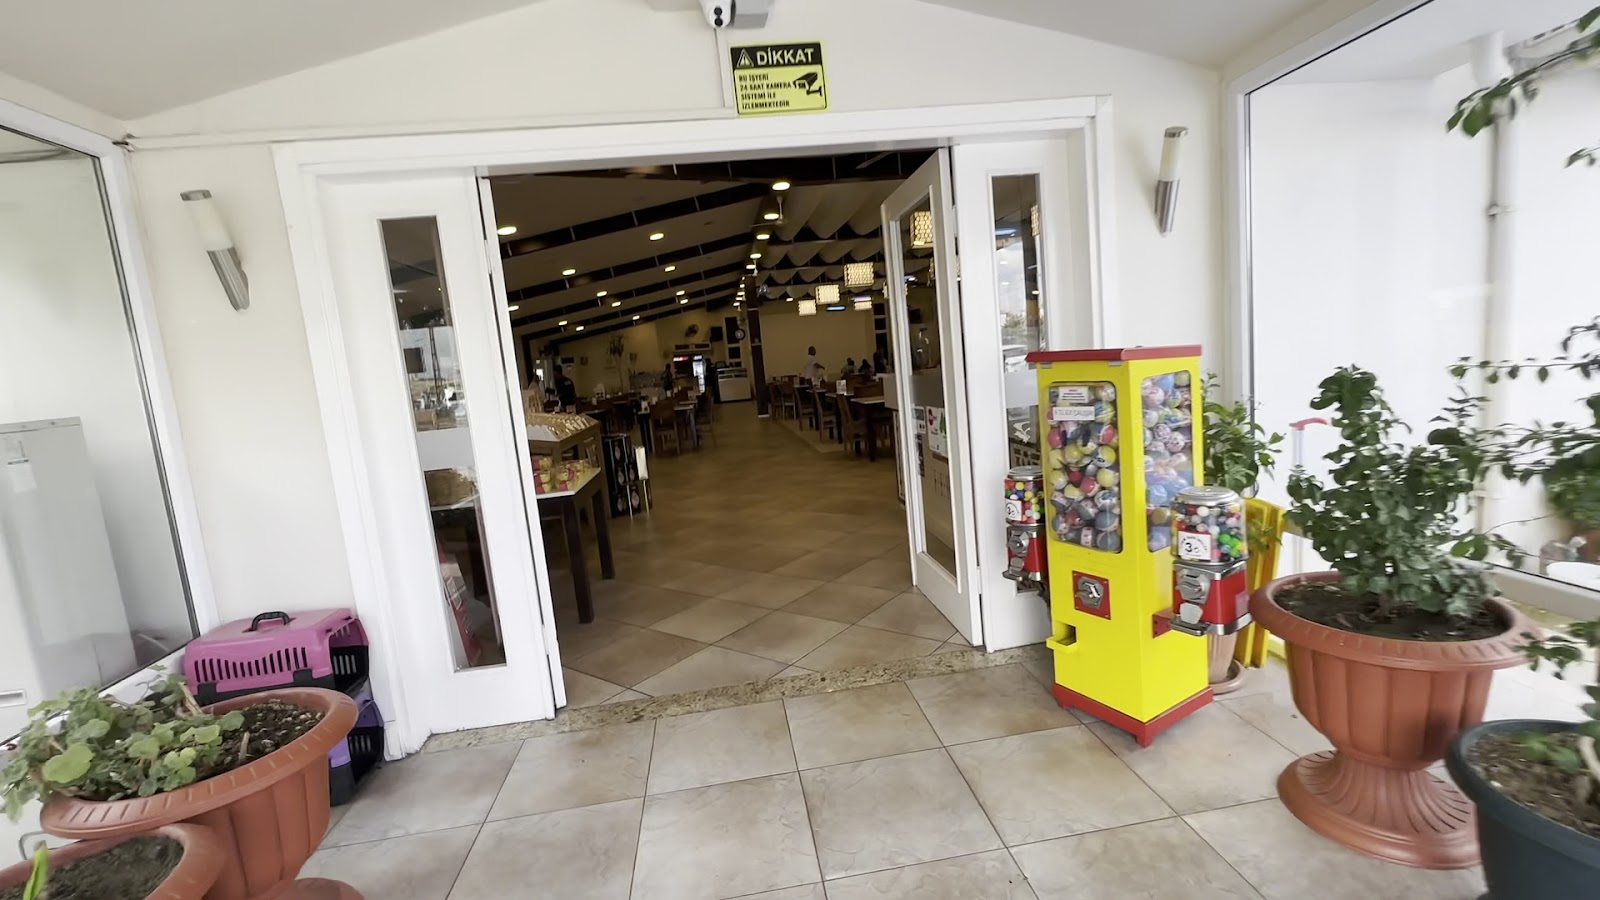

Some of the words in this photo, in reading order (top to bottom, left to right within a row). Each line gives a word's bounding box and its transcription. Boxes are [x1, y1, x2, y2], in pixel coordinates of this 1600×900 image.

[756, 47, 814, 66] DİKKAT
[766, 81, 792, 89] KAMERA
[742, 100, 790, 110] İZLENMEKTEDİR
